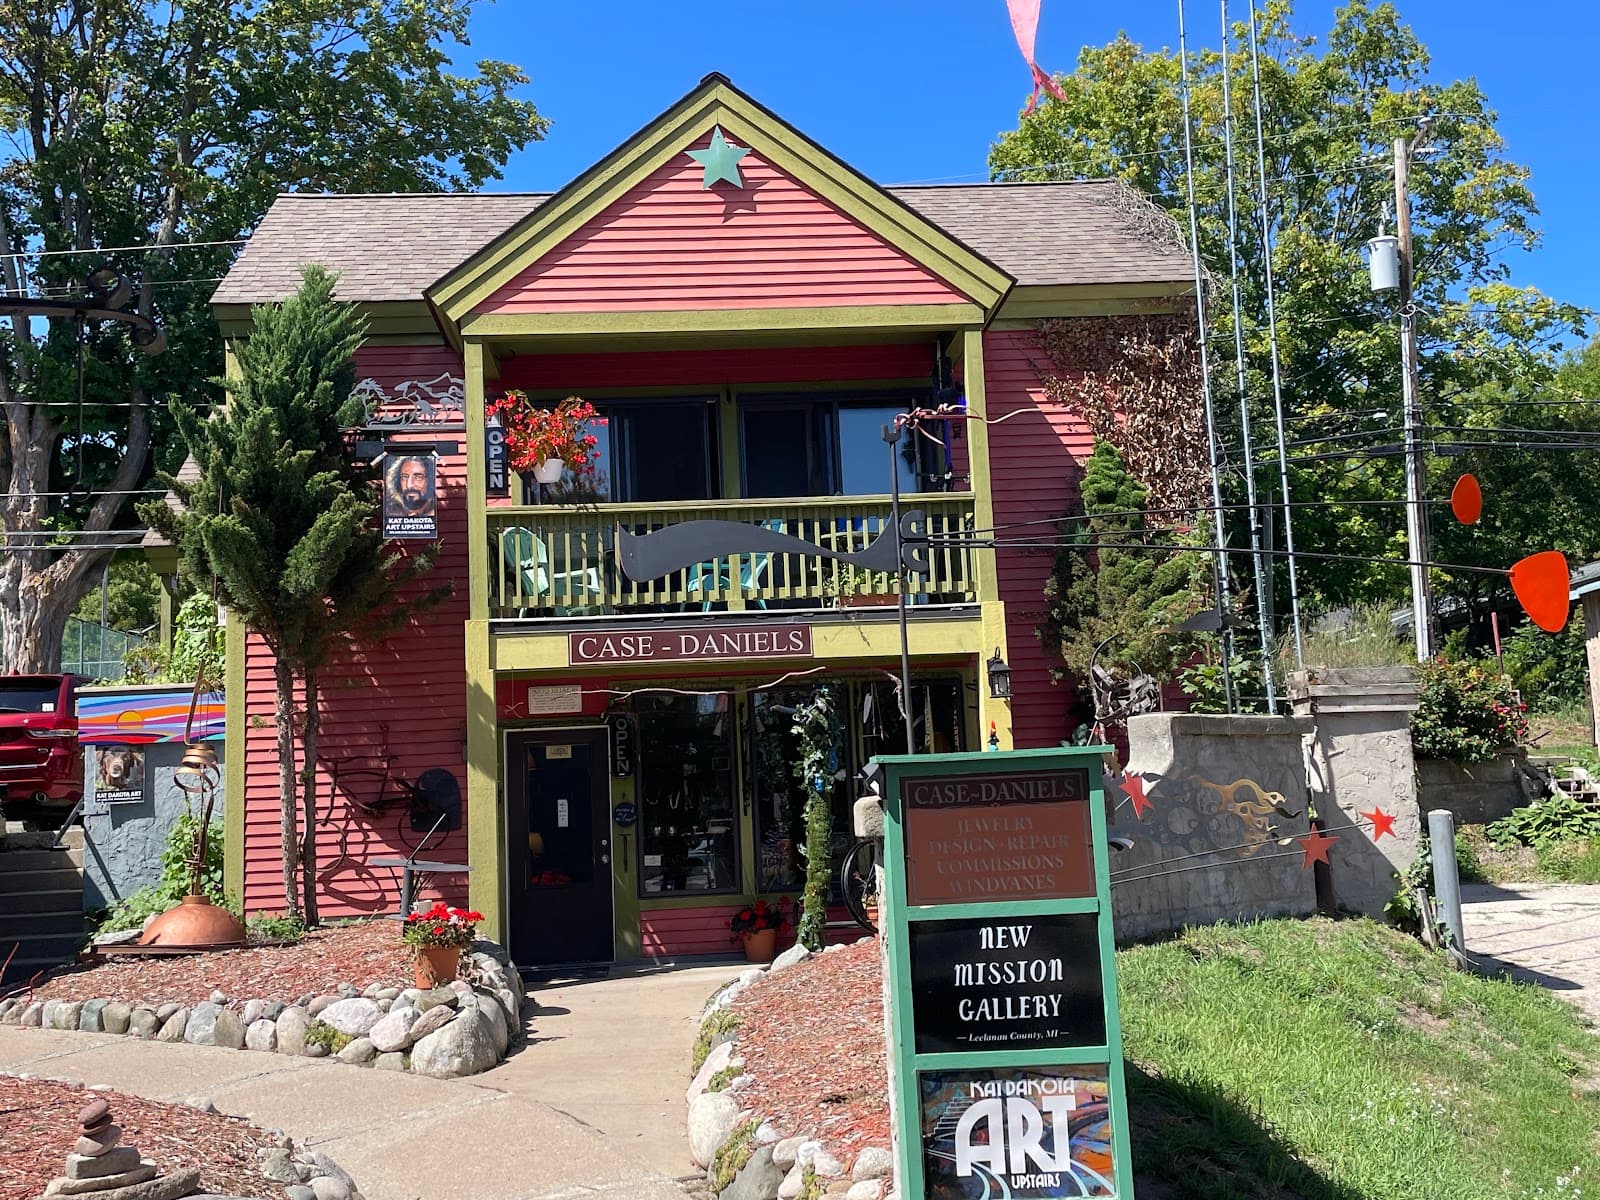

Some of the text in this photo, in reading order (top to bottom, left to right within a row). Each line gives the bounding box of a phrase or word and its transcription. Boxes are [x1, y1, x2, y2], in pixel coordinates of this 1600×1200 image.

[488, 430, 504, 488] OPEN
[578, 635, 654, 659] CASE
[679, 630, 804, 655] DANIELS
[615, 718, 630, 773] OPEN
[958, 815, 1034, 836] JEWELRY
[929, 834, 1070, 856] DESIGN REPAIR
[937, 854, 1065, 875] COMMISSIONS
[949, 874, 1057, 894] WINDVANES
[979, 925, 1033, 950] NEW
[954, 957, 1064, 987] MISSION
[958, 993, 1062, 1022] GALLERY
[1046, 1029, 1059, 1039] MI
[1005, 1076, 1076, 1097] DAKOTA
[954, 1094, 1077, 1177] ART
[1011, 1173, 1060, 1189] UPSTAIRS
